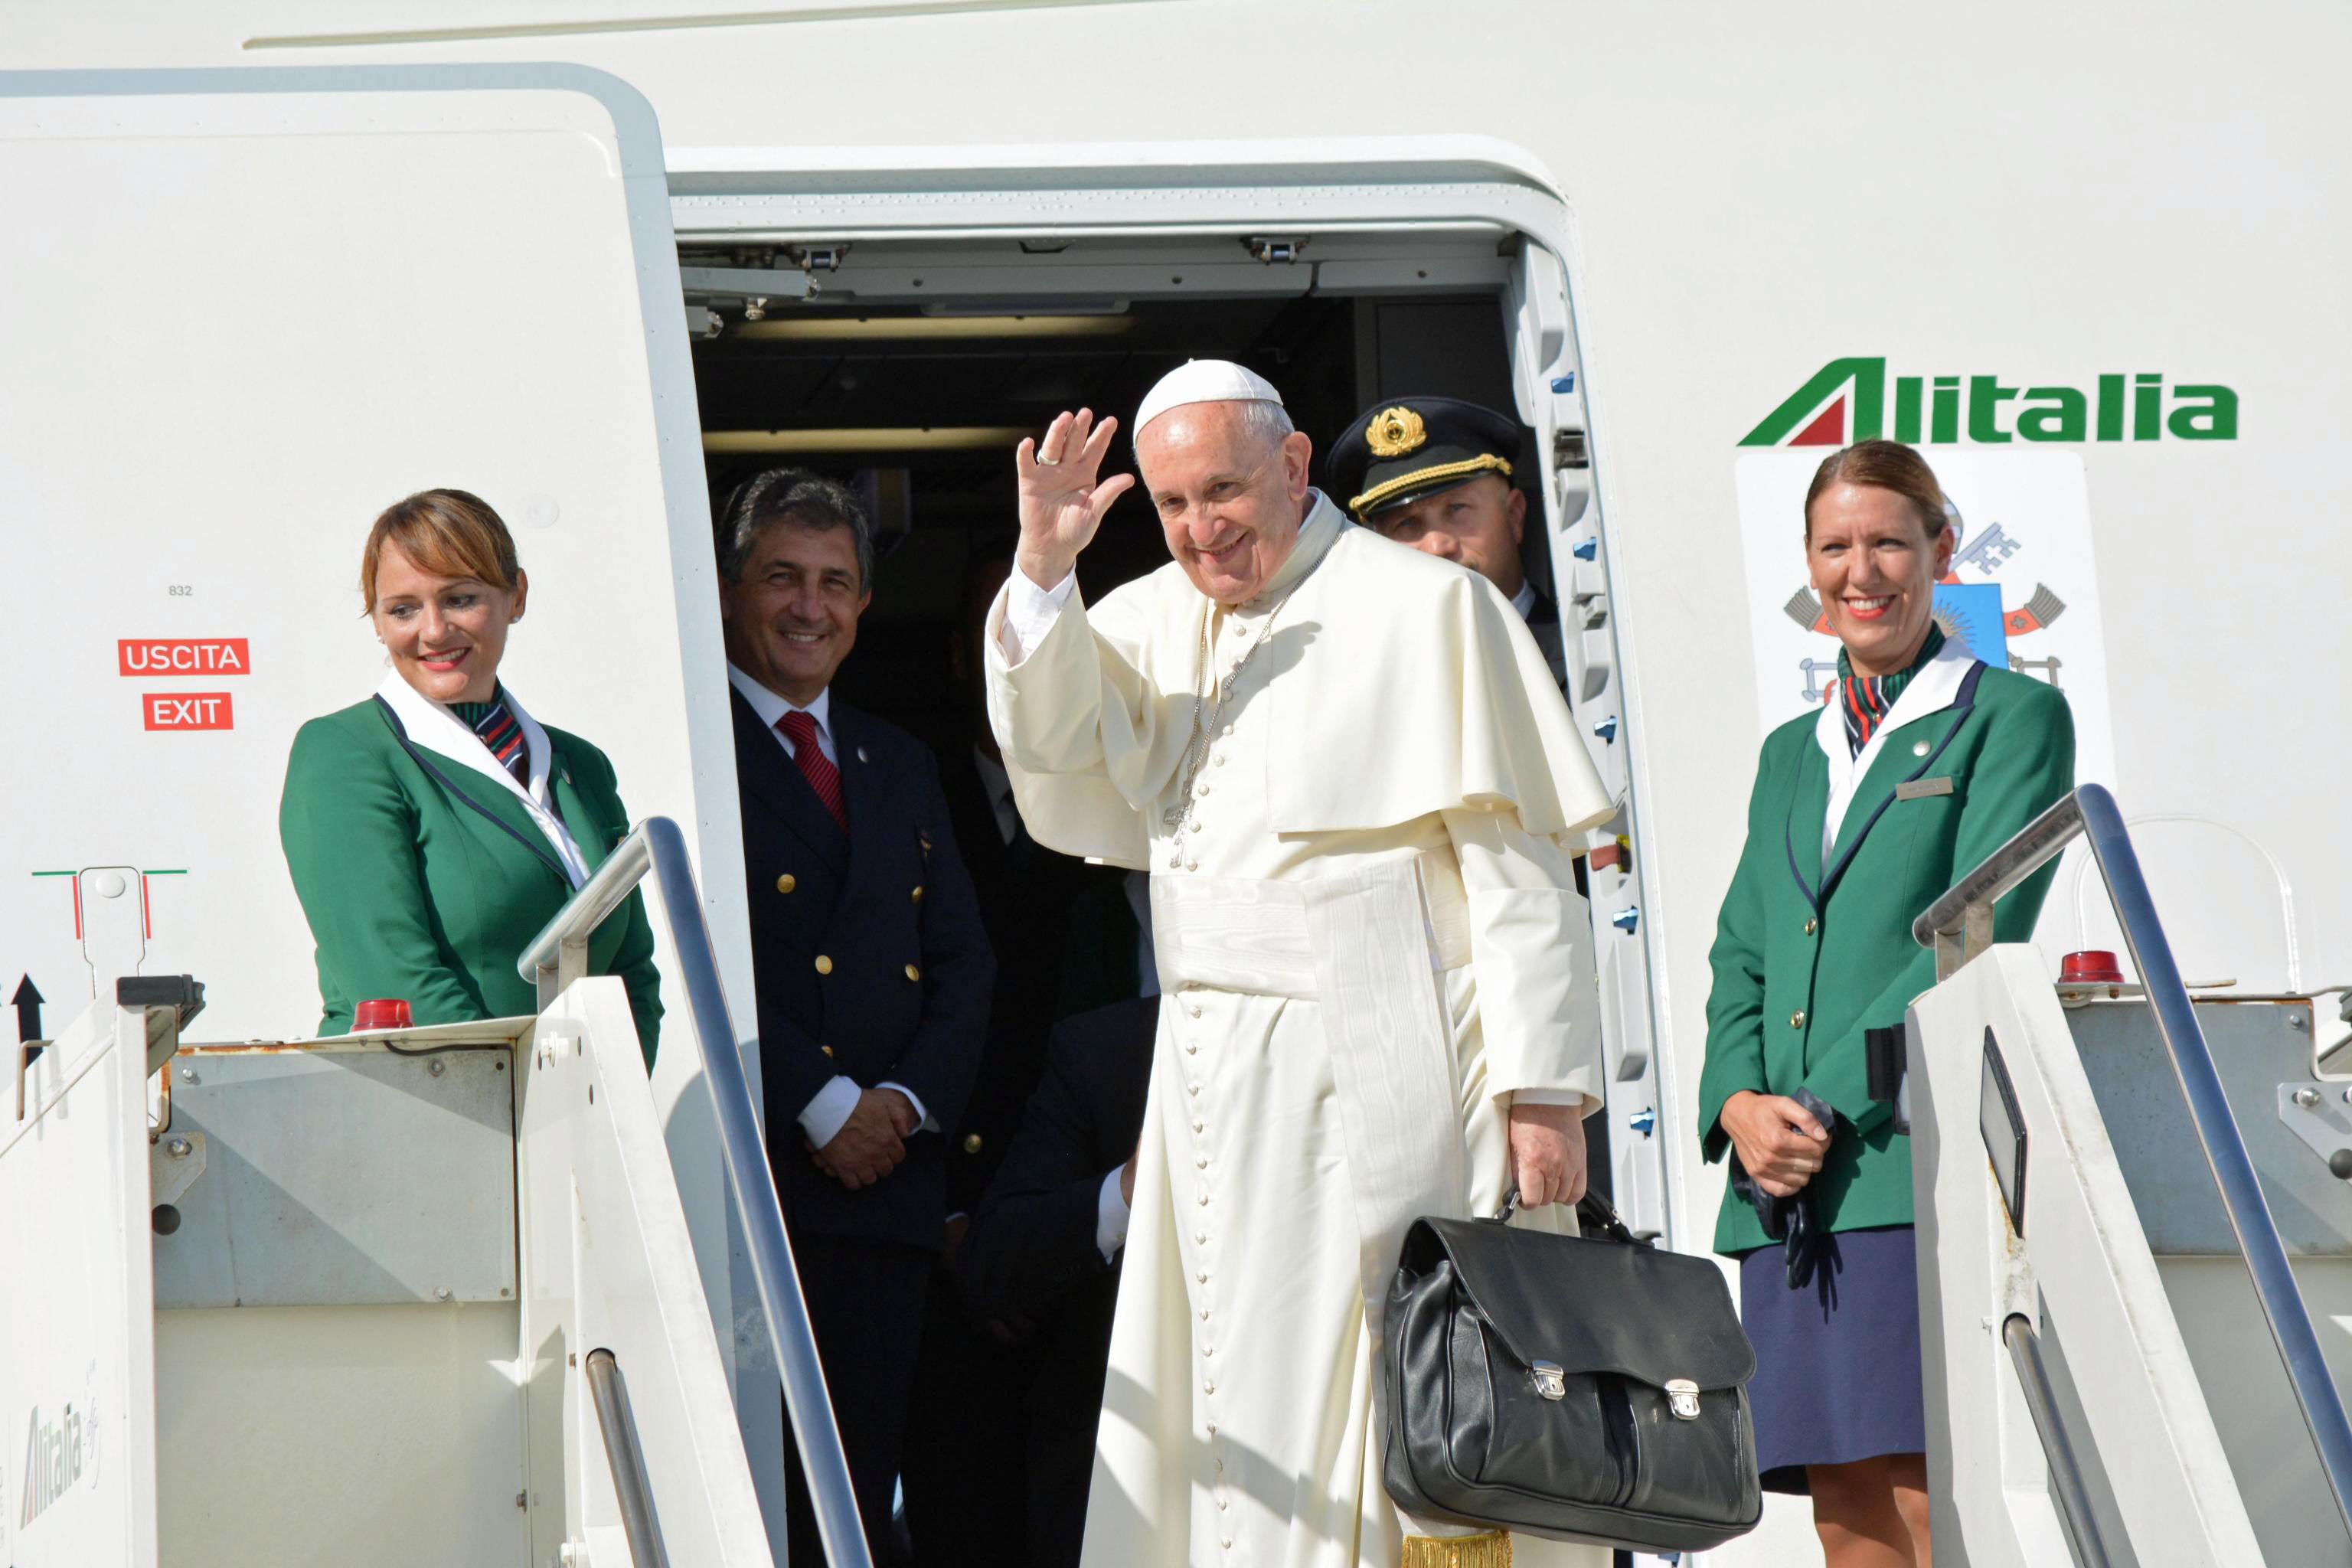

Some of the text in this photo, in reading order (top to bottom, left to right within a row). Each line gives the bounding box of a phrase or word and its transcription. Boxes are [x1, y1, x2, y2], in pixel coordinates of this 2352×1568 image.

[1736, 357, 2239, 446] Alitalia
[168, 586, 192, 596] 832
[126, 645, 242, 670] USCITA
[153, 699, 221, 724] EXIT
[20, 1401, 81, 1531] Alitalia
